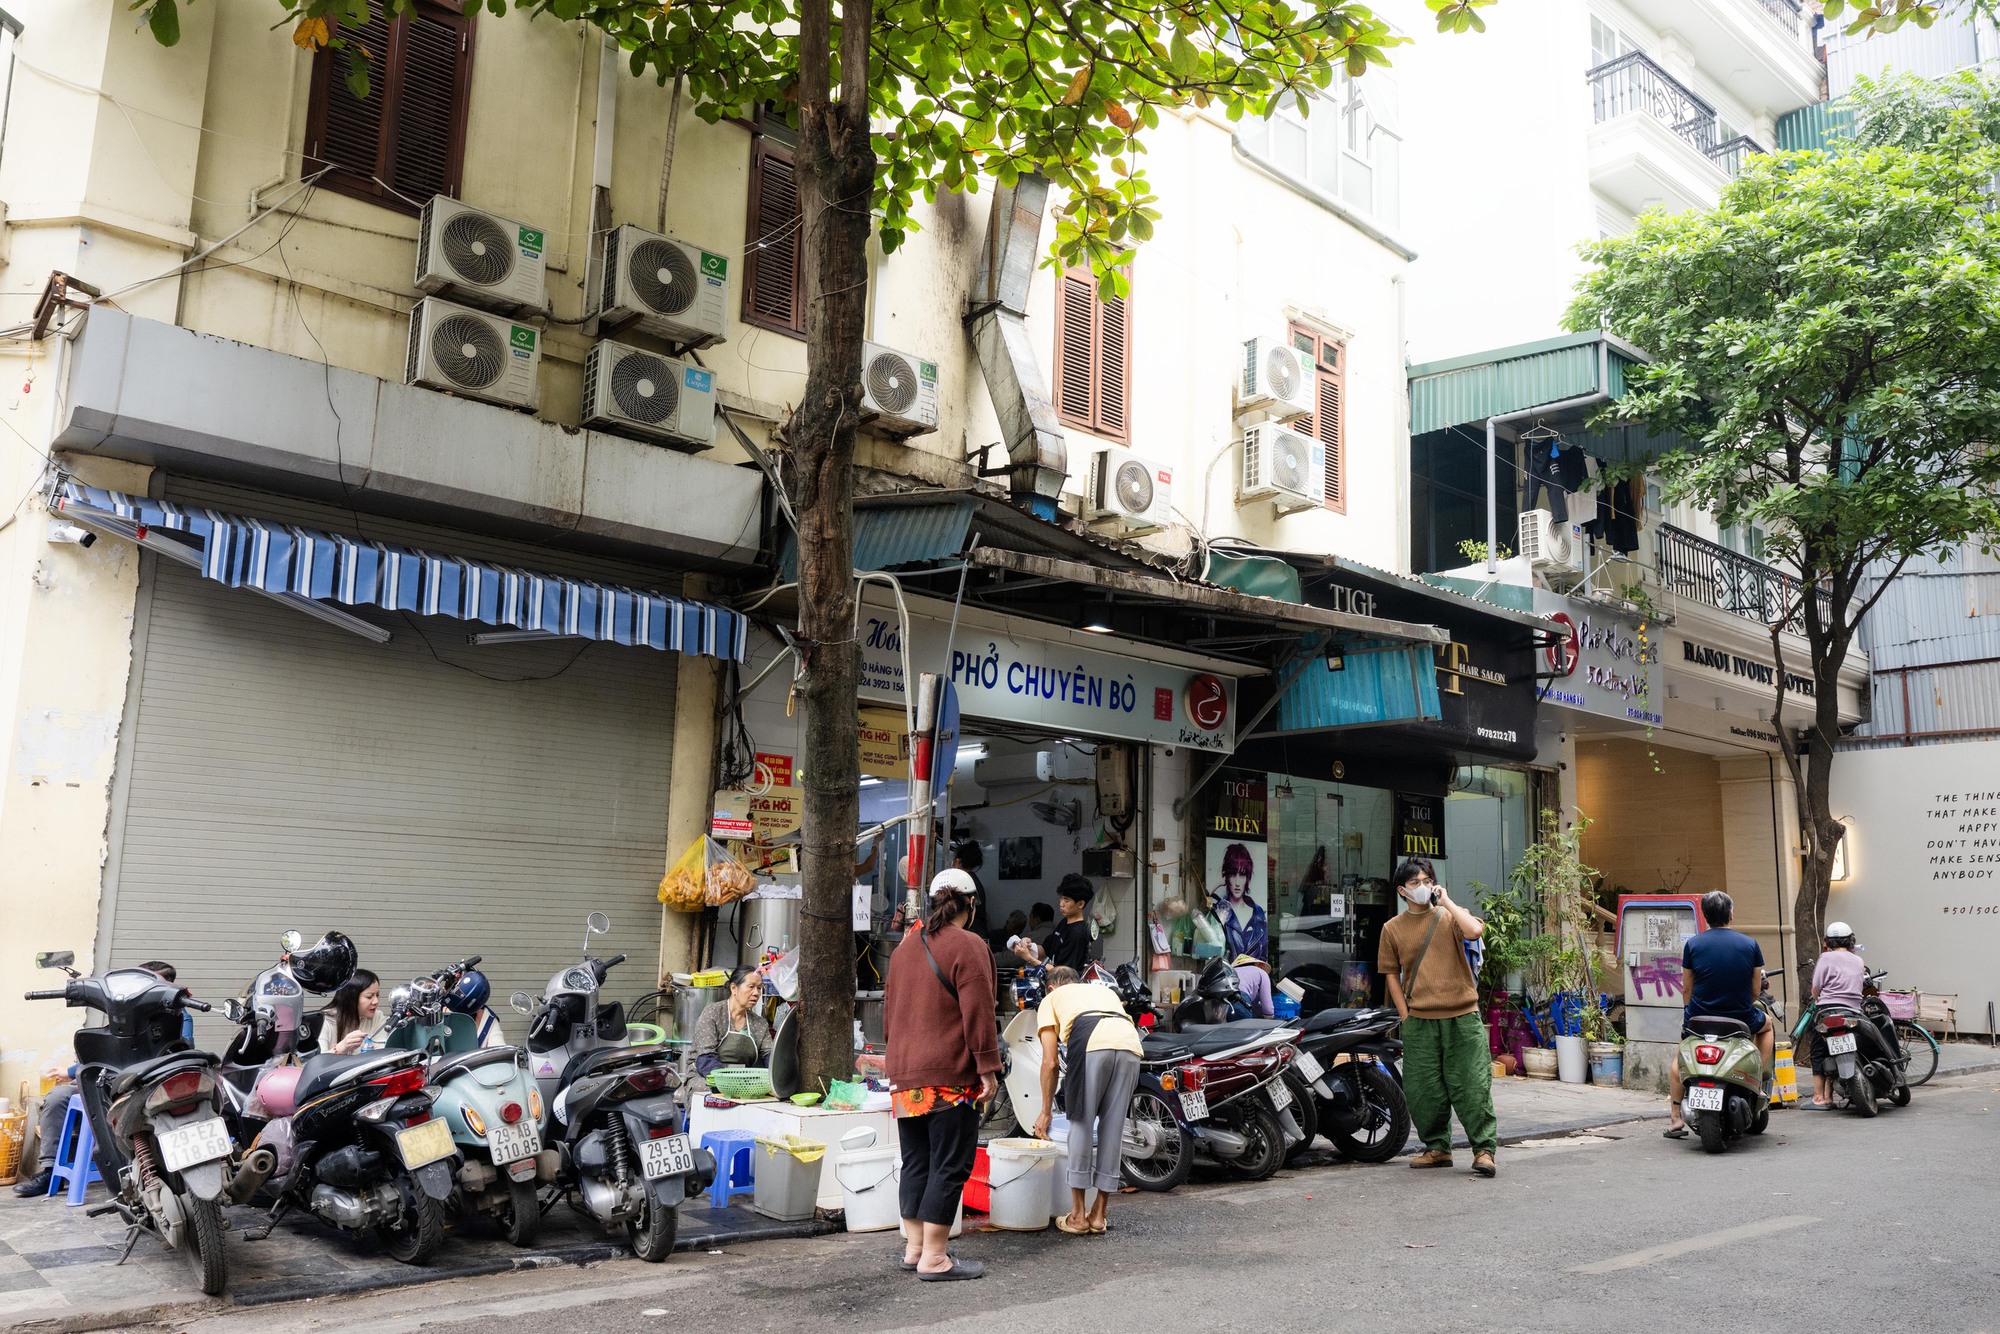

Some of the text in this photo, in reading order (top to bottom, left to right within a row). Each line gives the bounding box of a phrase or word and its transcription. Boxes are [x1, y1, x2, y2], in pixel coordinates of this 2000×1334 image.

[701, 266, 726, 279] Nagakawa
[687, 376, 709, 390] Casper
[1329, 583, 1375, 617] TIGI
[869, 660, 892, 676] HÀNG
[1683, 641, 1731, 672] HANOI
[1733, 656, 1774, 685] IVORY
[951, 642, 1000, 689] PHỞ
[1007, 661, 1103, 708] CHUYÊN
[1109, 673, 1136, 713] BÒ
[1459, 662, 1506, 683] HAIR SALON
[1587, 665, 1603, 686] 50
[873, 679, 890, 690] 3923
[1224, 781, 1249, 798] TIGI
[1935, 794, 1958, 803] THE
[1410, 805, 1430, 820] TIGI
[1926, 808, 1997, 819] THAT MAKE
[1214, 814, 1260, 835] DUYÊN
[1959, 823, 1998, 833] HAPPY
[1403, 827, 1440, 855] TÌNH
[1926, 840, 1967, 849] DON'T
[1930, 855, 1963, 865] MAKE
[1933, 870, 1993, 880] ANYBODY
[1693, 1088, 1719, 1100] 29-C2
[1689, 1098, 1721, 1110] 034.12
[170, 1123, 218, 1149] 29-E2
[495, 1122, 531, 1145] 29-AB
[171, 1137, 228, 1167] 118.68
[494, 1137, 539, 1163] 310.85
[647, 1138, 683, 1160] 29-E3
[646, 1154, 692, 1177] 025.80
